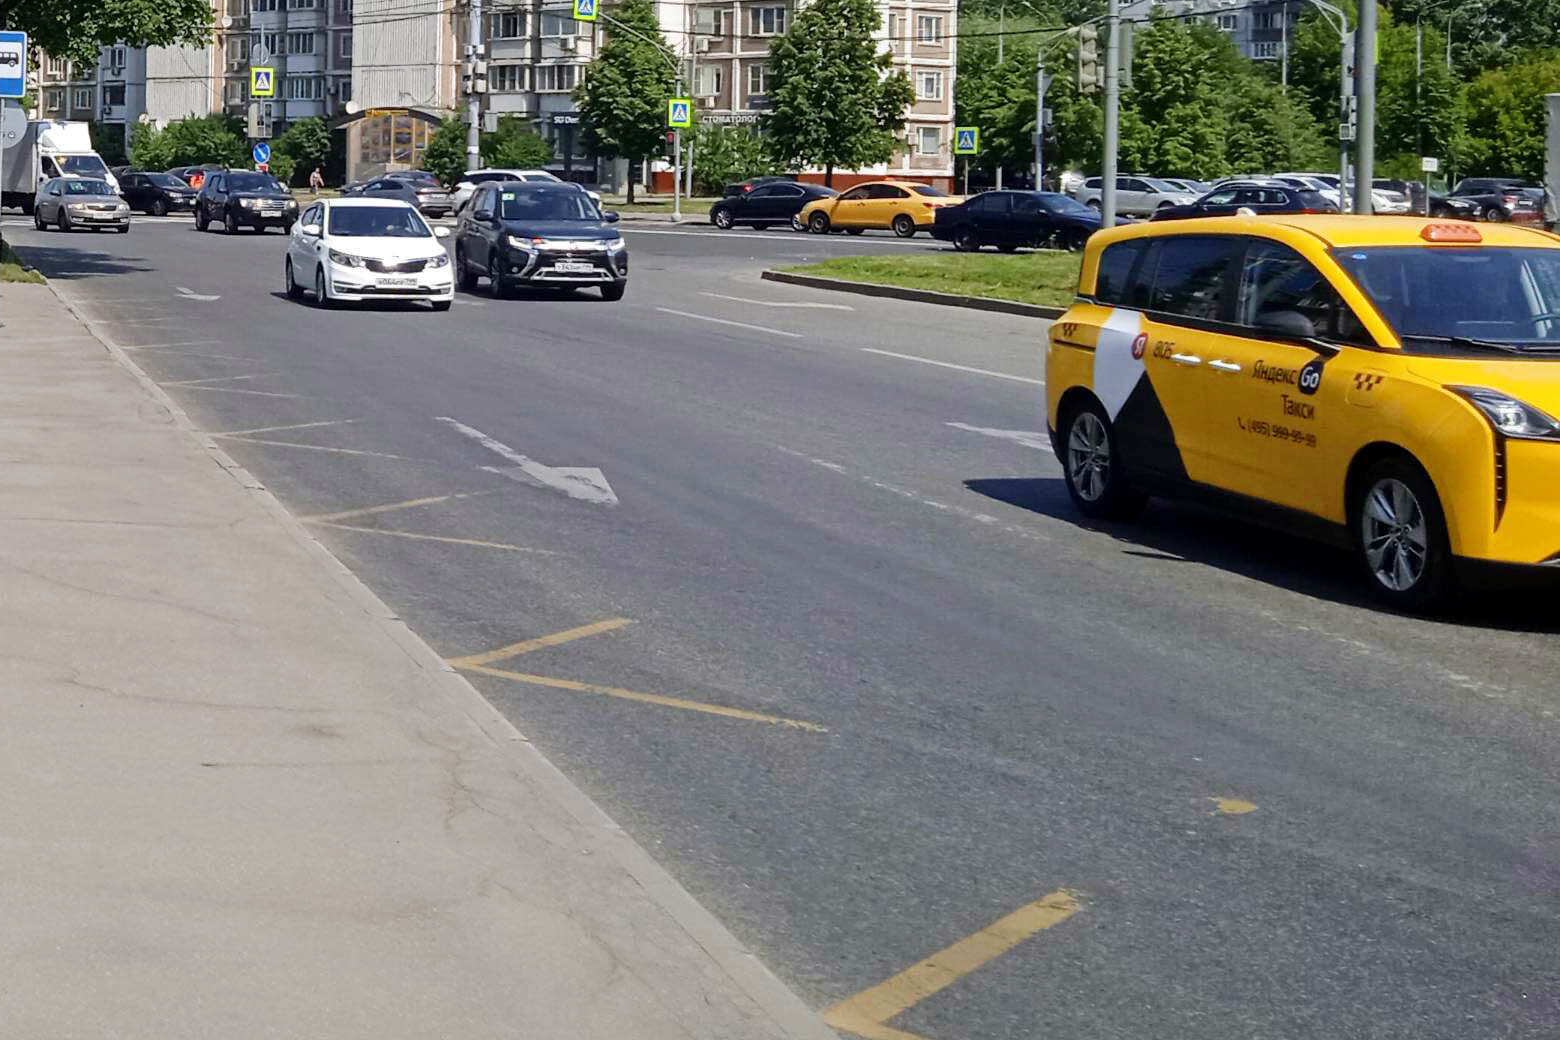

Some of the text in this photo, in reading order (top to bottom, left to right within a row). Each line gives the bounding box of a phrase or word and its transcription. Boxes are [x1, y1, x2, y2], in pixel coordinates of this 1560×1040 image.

[702, 114, 760, 124] СТОМАТОЛОГ
[1251, 359, 1320, 388] Яндекс Go
[1281, 393, 1315, 420] Такси
